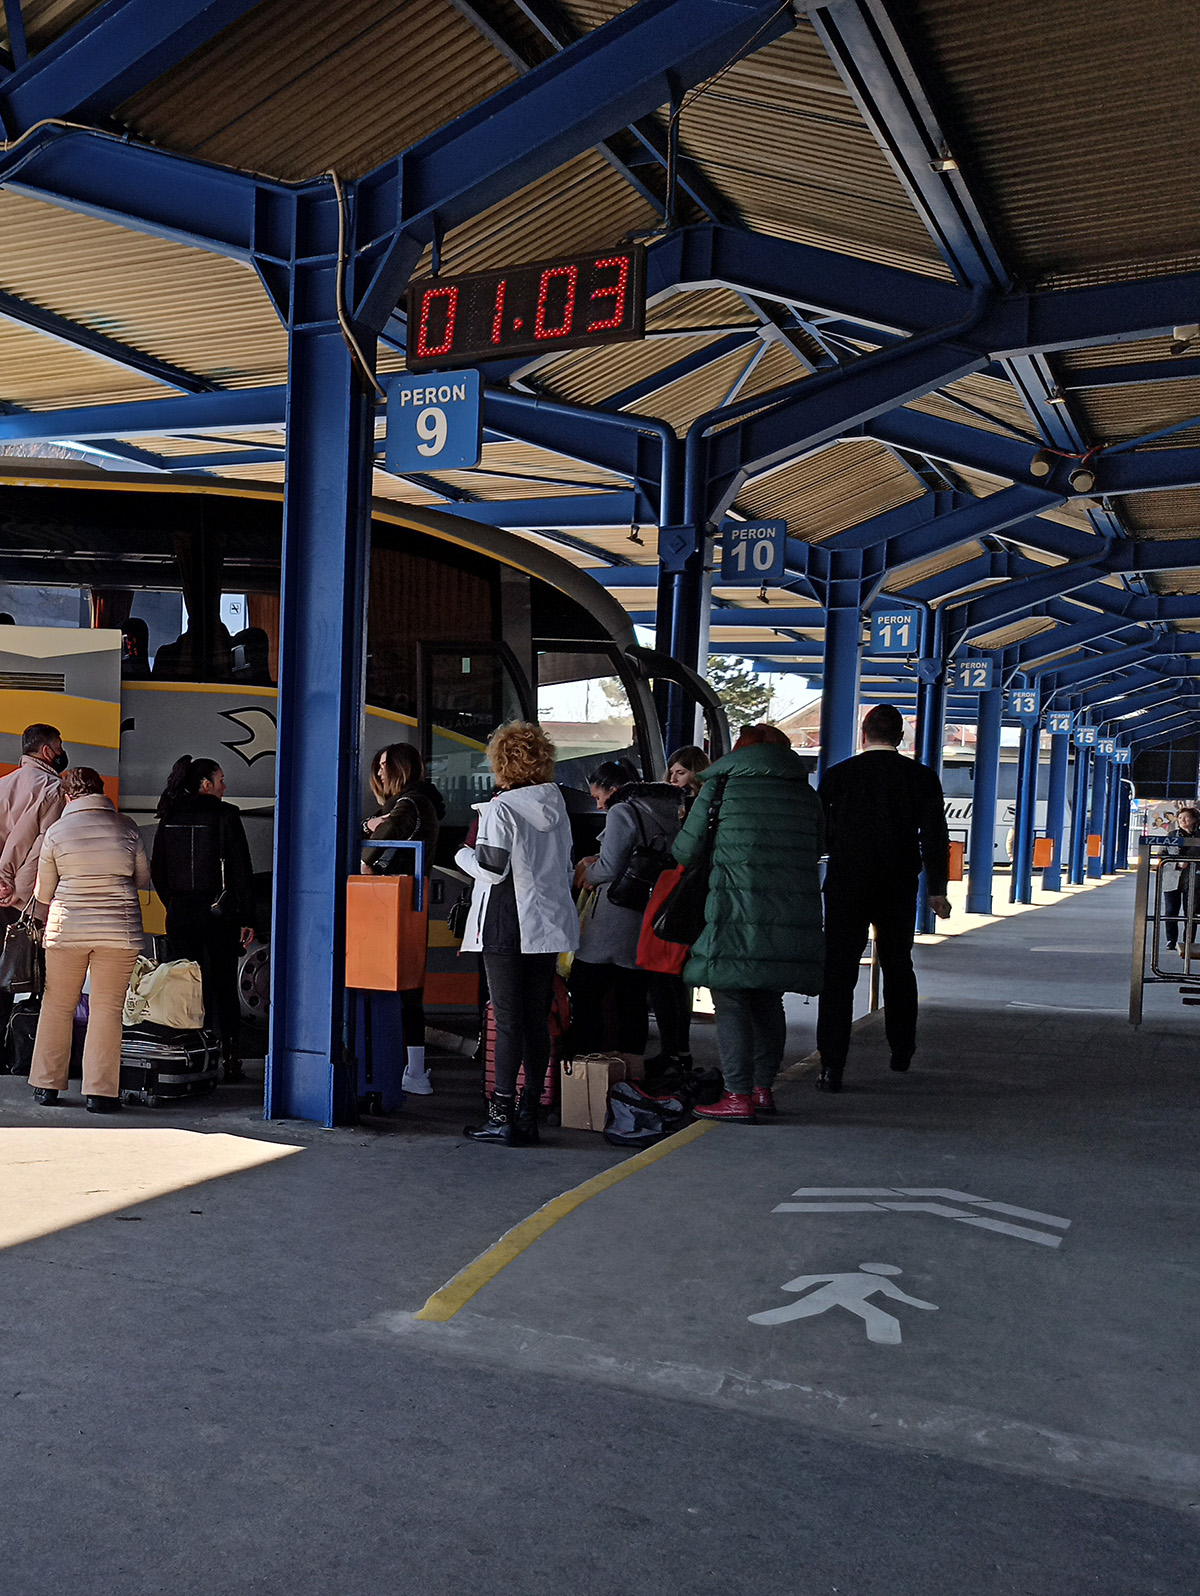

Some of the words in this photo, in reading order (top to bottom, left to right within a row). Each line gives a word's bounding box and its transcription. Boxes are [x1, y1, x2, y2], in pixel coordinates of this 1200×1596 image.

[417, 255, 629, 357] 01.03
[400, 384, 466, 407] PERON
[416, 408, 448, 457] 9
[731, 527, 776, 540] PERON
[731, 540, 775, 572] 10
[877, 615, 911, 625] PERON
[878, 625, 909, 647] 11
[960, 661, 988, 669] PERON
[959, 669, 987, 687] 12
[1011, 699, 1036, 714] 13
[1049, 719, 1070, 732] 14
[1076, 732, 1095, 744] 15
[1097, 743, 1114, 754] 16
[1114, 752, 1129, 762] 17
[1145, 836, 1179, 845] IZLAZ
